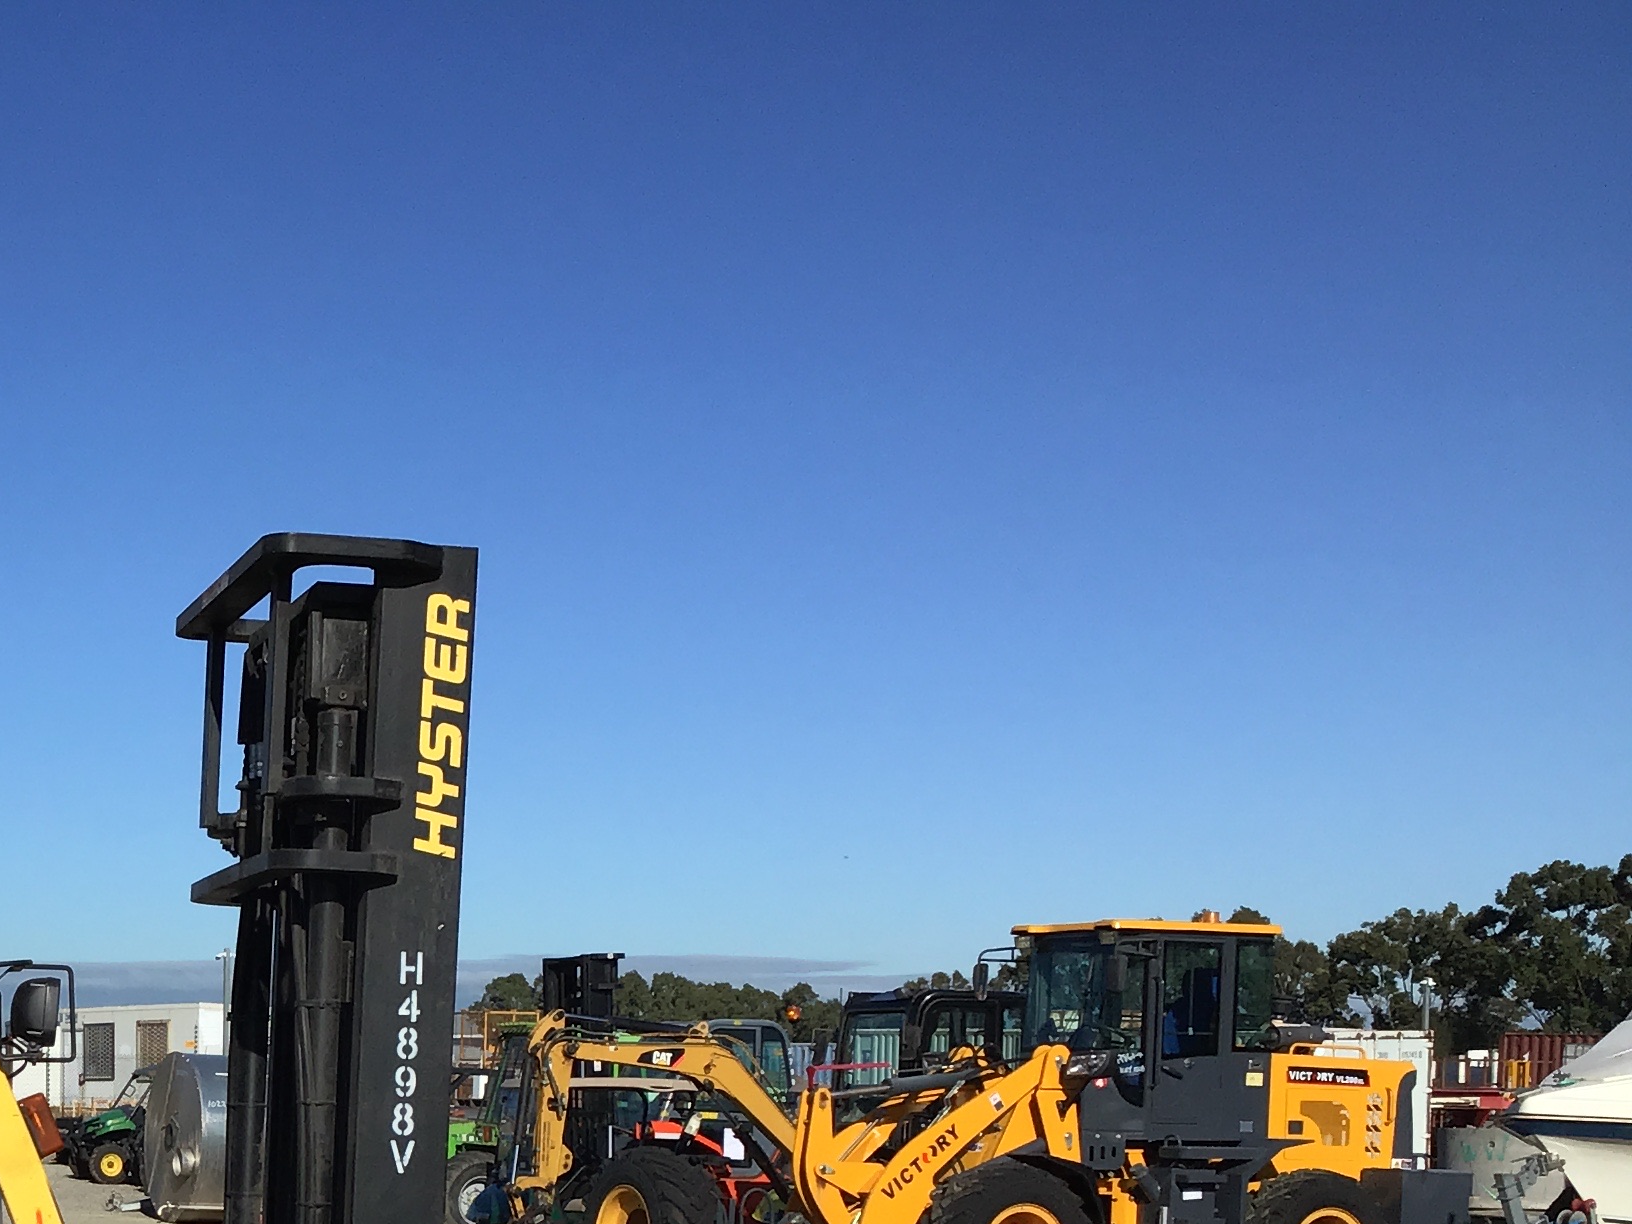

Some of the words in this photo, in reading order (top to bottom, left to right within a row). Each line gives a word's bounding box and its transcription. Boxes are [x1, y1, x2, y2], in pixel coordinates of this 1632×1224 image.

[413, 592, 471, 860] HYSTER
[390, 950, 424, 1175] H4898V
[652, 1050, 673, 1066] CAT
[880, 1123, 959, 1199] VICTORY
